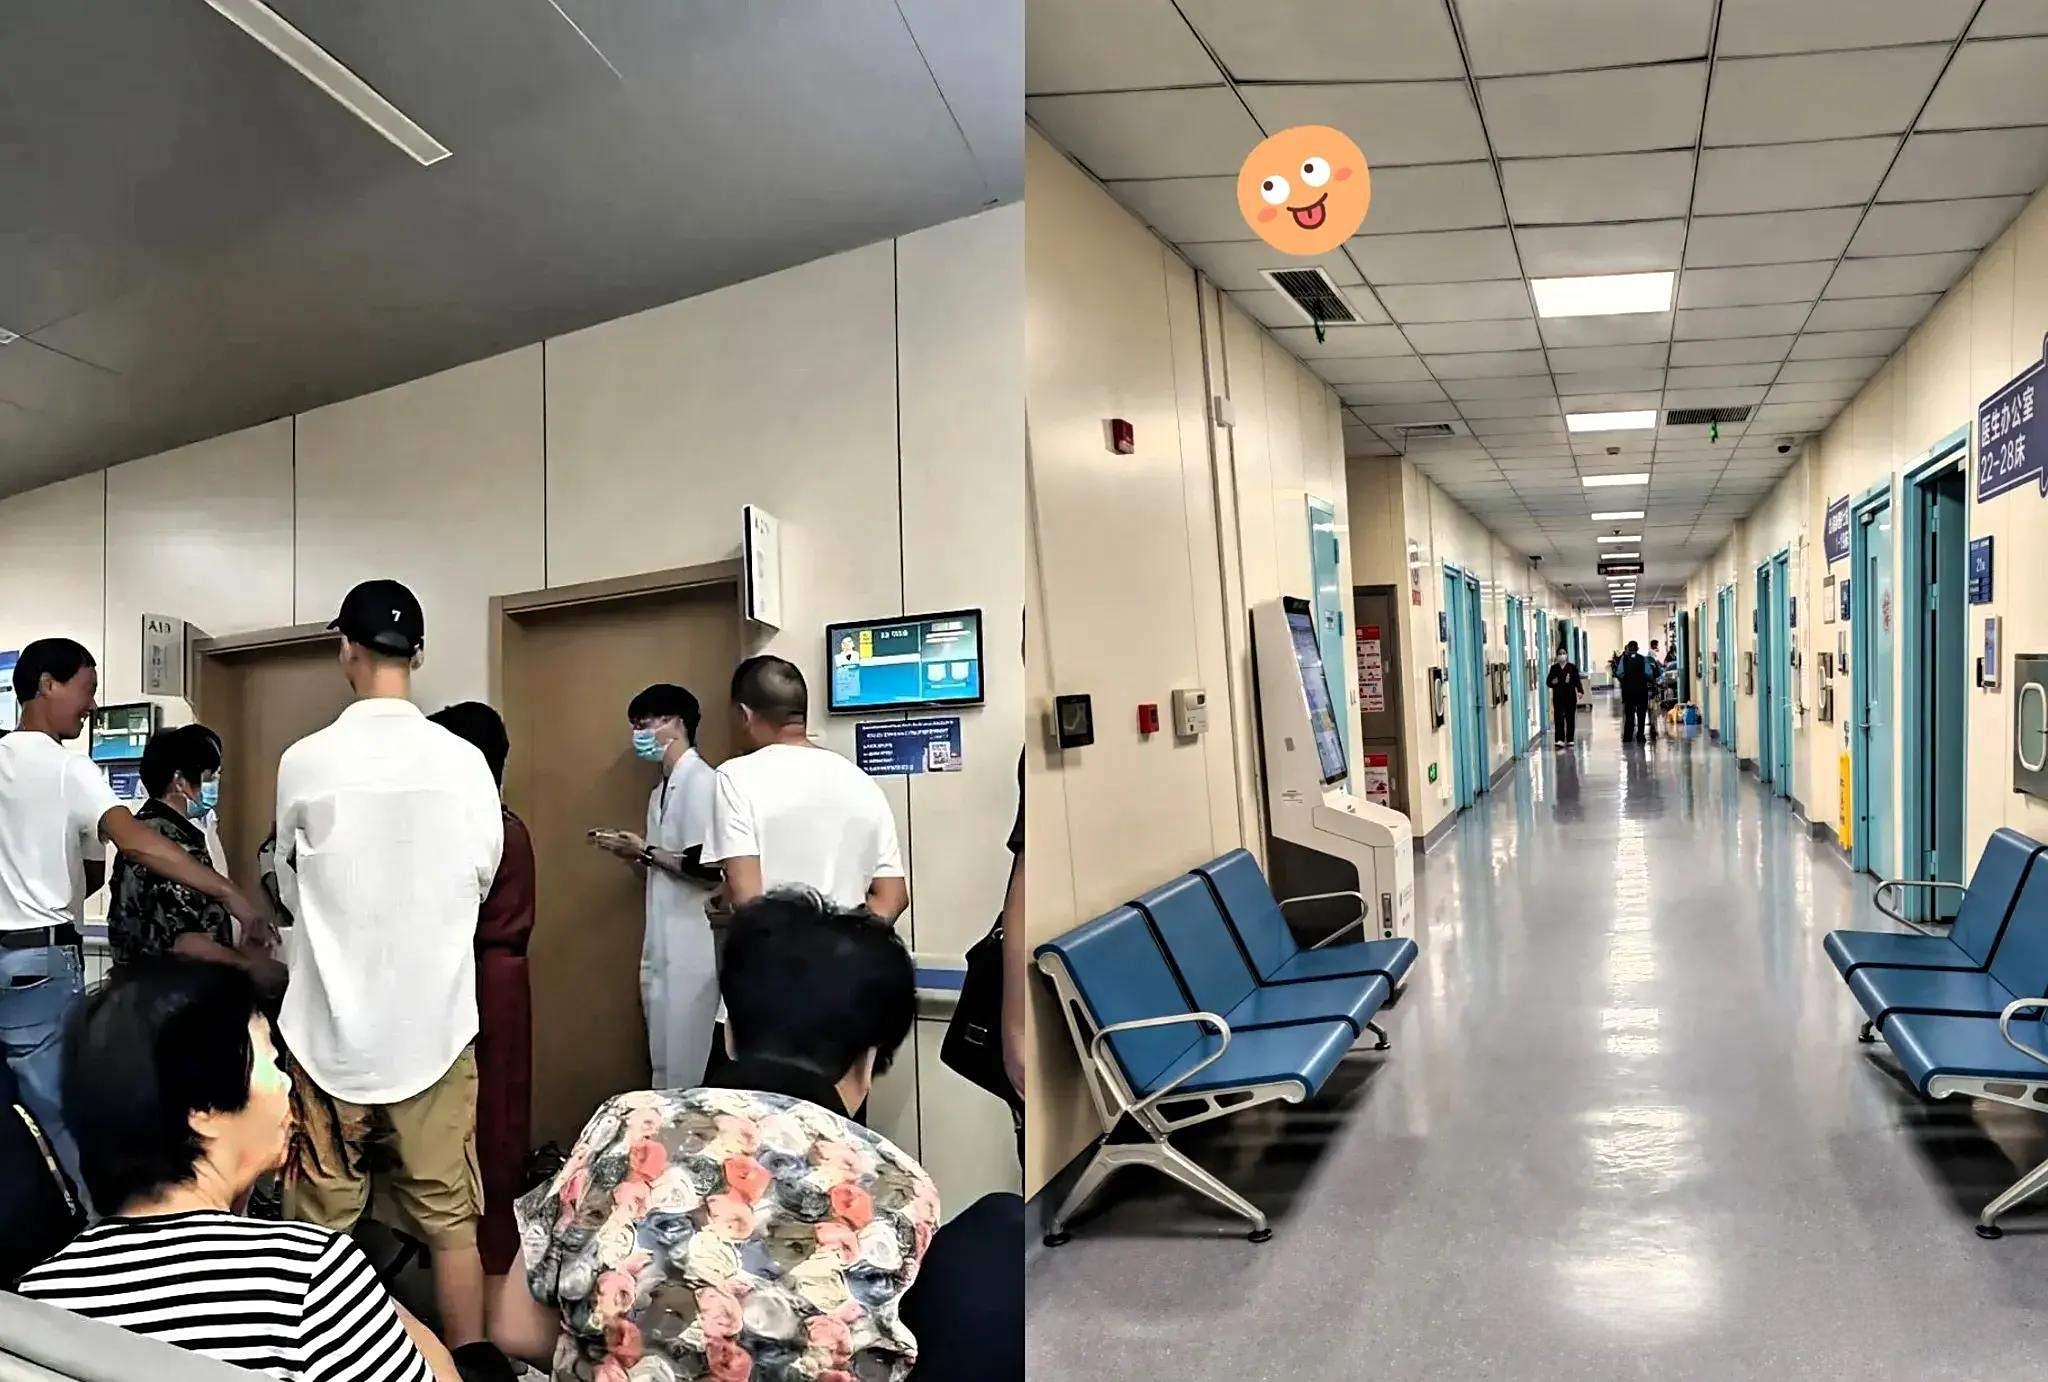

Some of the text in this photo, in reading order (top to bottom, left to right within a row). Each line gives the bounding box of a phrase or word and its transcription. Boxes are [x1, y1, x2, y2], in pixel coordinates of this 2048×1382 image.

[1981, 385, 2034, 448] 医生办公室
[1980, 432, 2026, 484] 22-28床
[391, 608, 401, 622] 7
